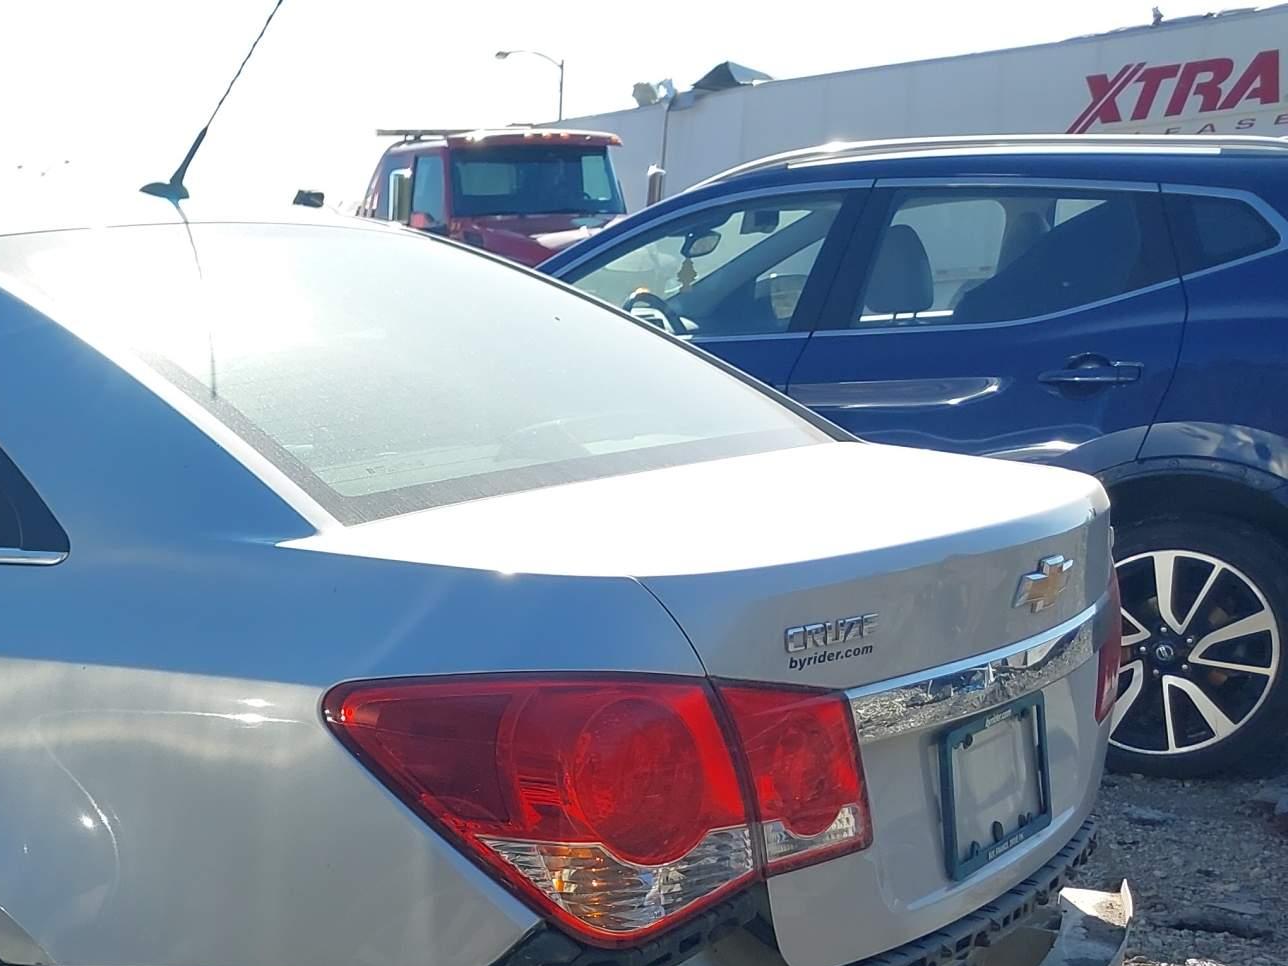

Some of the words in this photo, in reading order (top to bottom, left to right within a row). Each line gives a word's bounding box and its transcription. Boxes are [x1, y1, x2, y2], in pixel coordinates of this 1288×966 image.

[1065, 49, 1279, 134] XTRA
[1134, 113, 1288, 135] EASE
[785, 612, 879, 653] CRUZE
[789, 644, 873, 670] byrider.com
